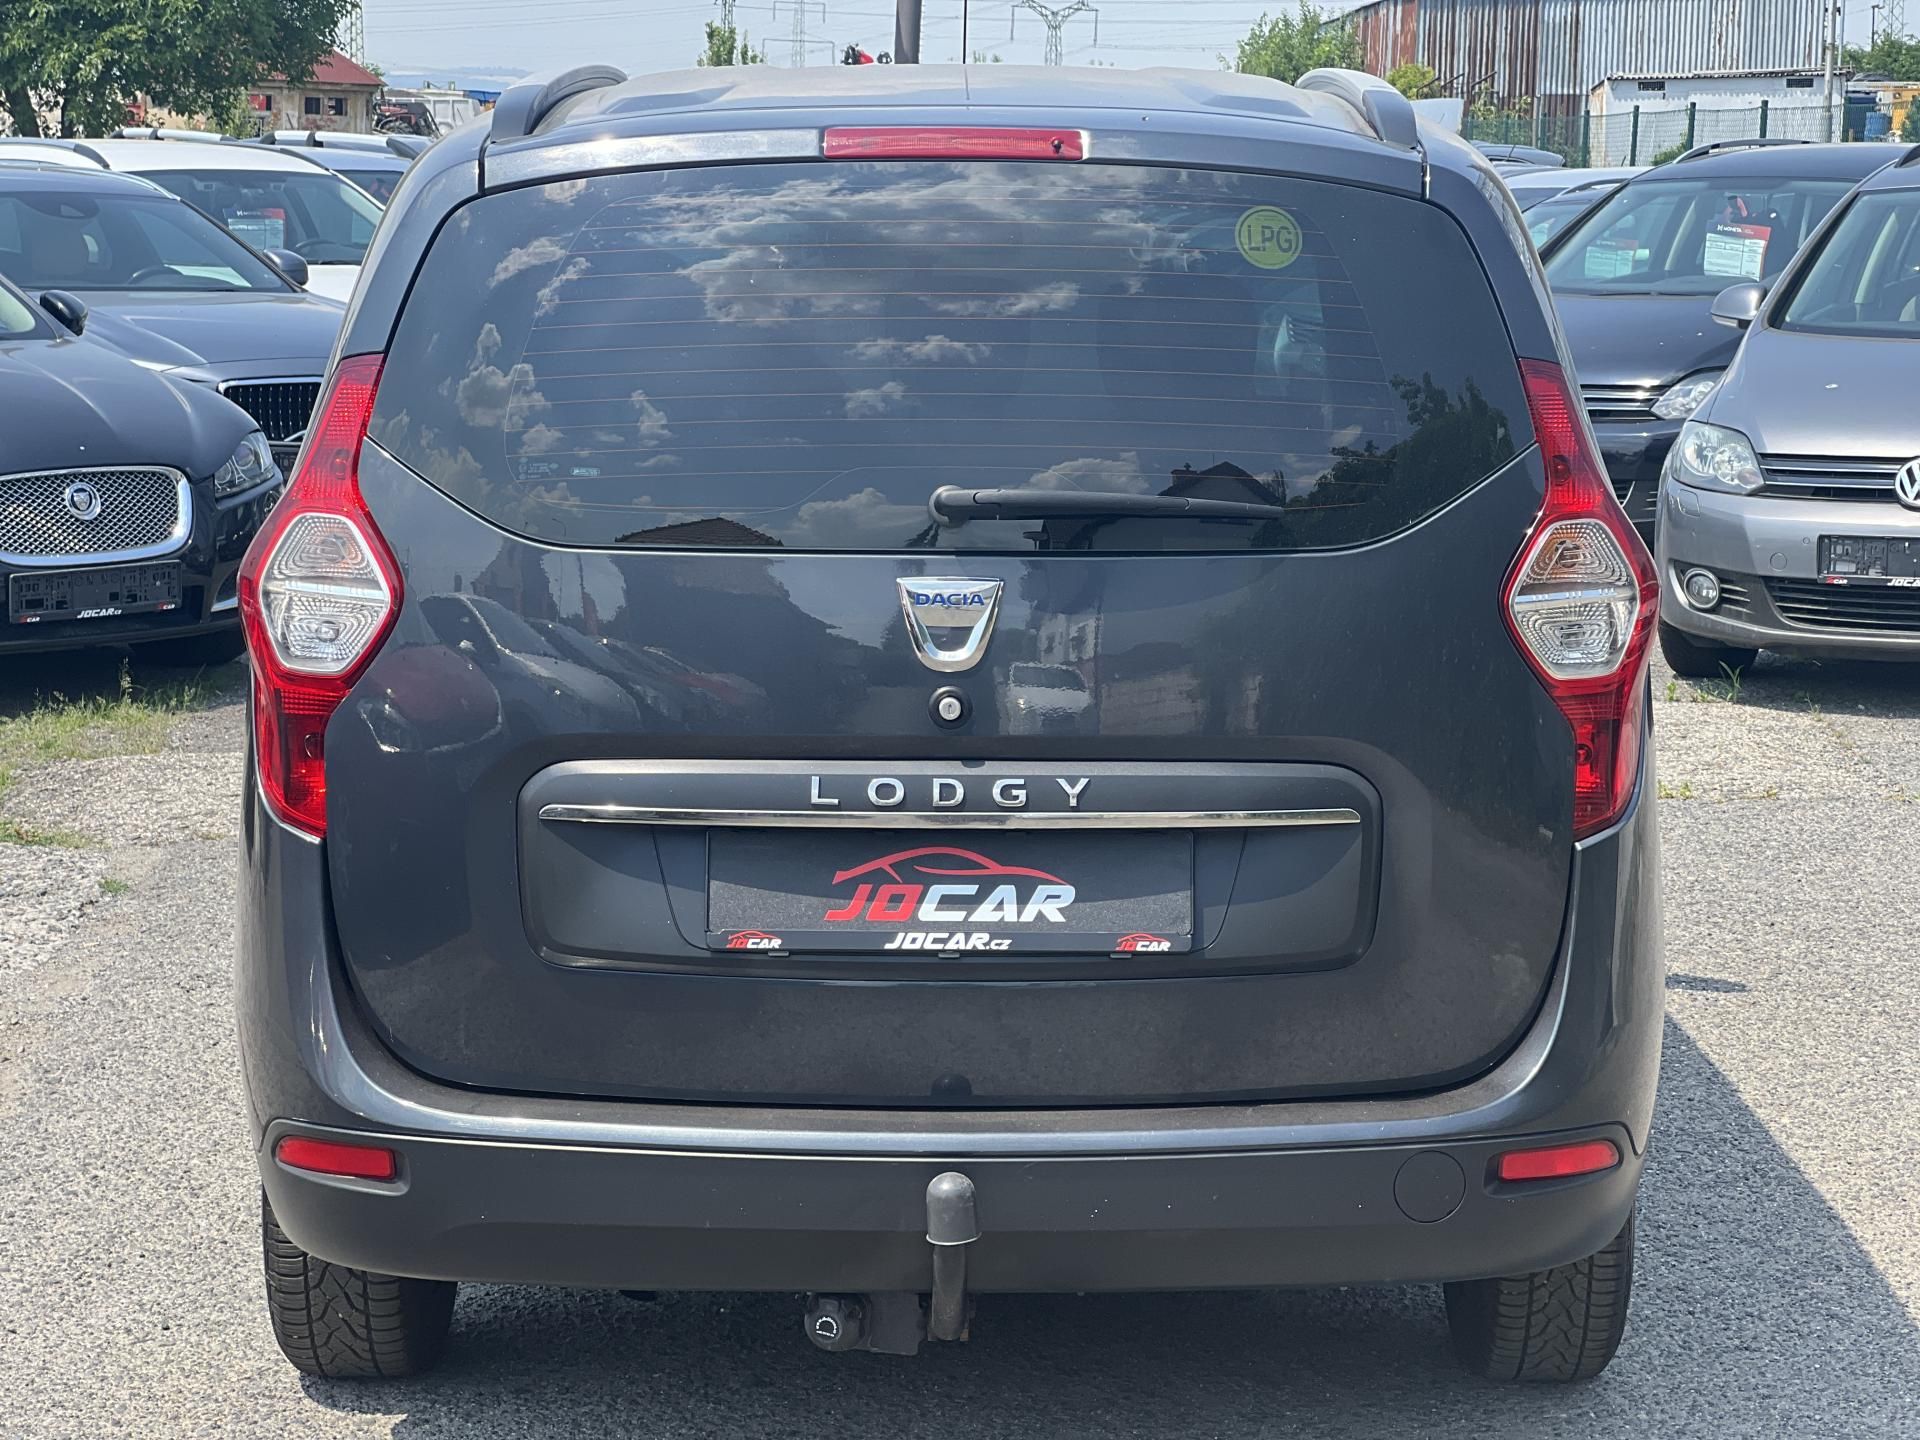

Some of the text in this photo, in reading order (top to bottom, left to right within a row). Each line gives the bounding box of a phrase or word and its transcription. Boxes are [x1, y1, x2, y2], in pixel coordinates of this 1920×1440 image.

[1247, 224, 1293, 253] LPG
[914, 593, 985, 606] DACIA
[810, 775, 1090, 807] LODGY
[824, 884, 1076, 922] JOCAR
[726, 938, 783, 949] JOCAR
[884, 932, 1012, 950] JOCAR.cz
[1115, 941, 1172, 952] JOCAR
